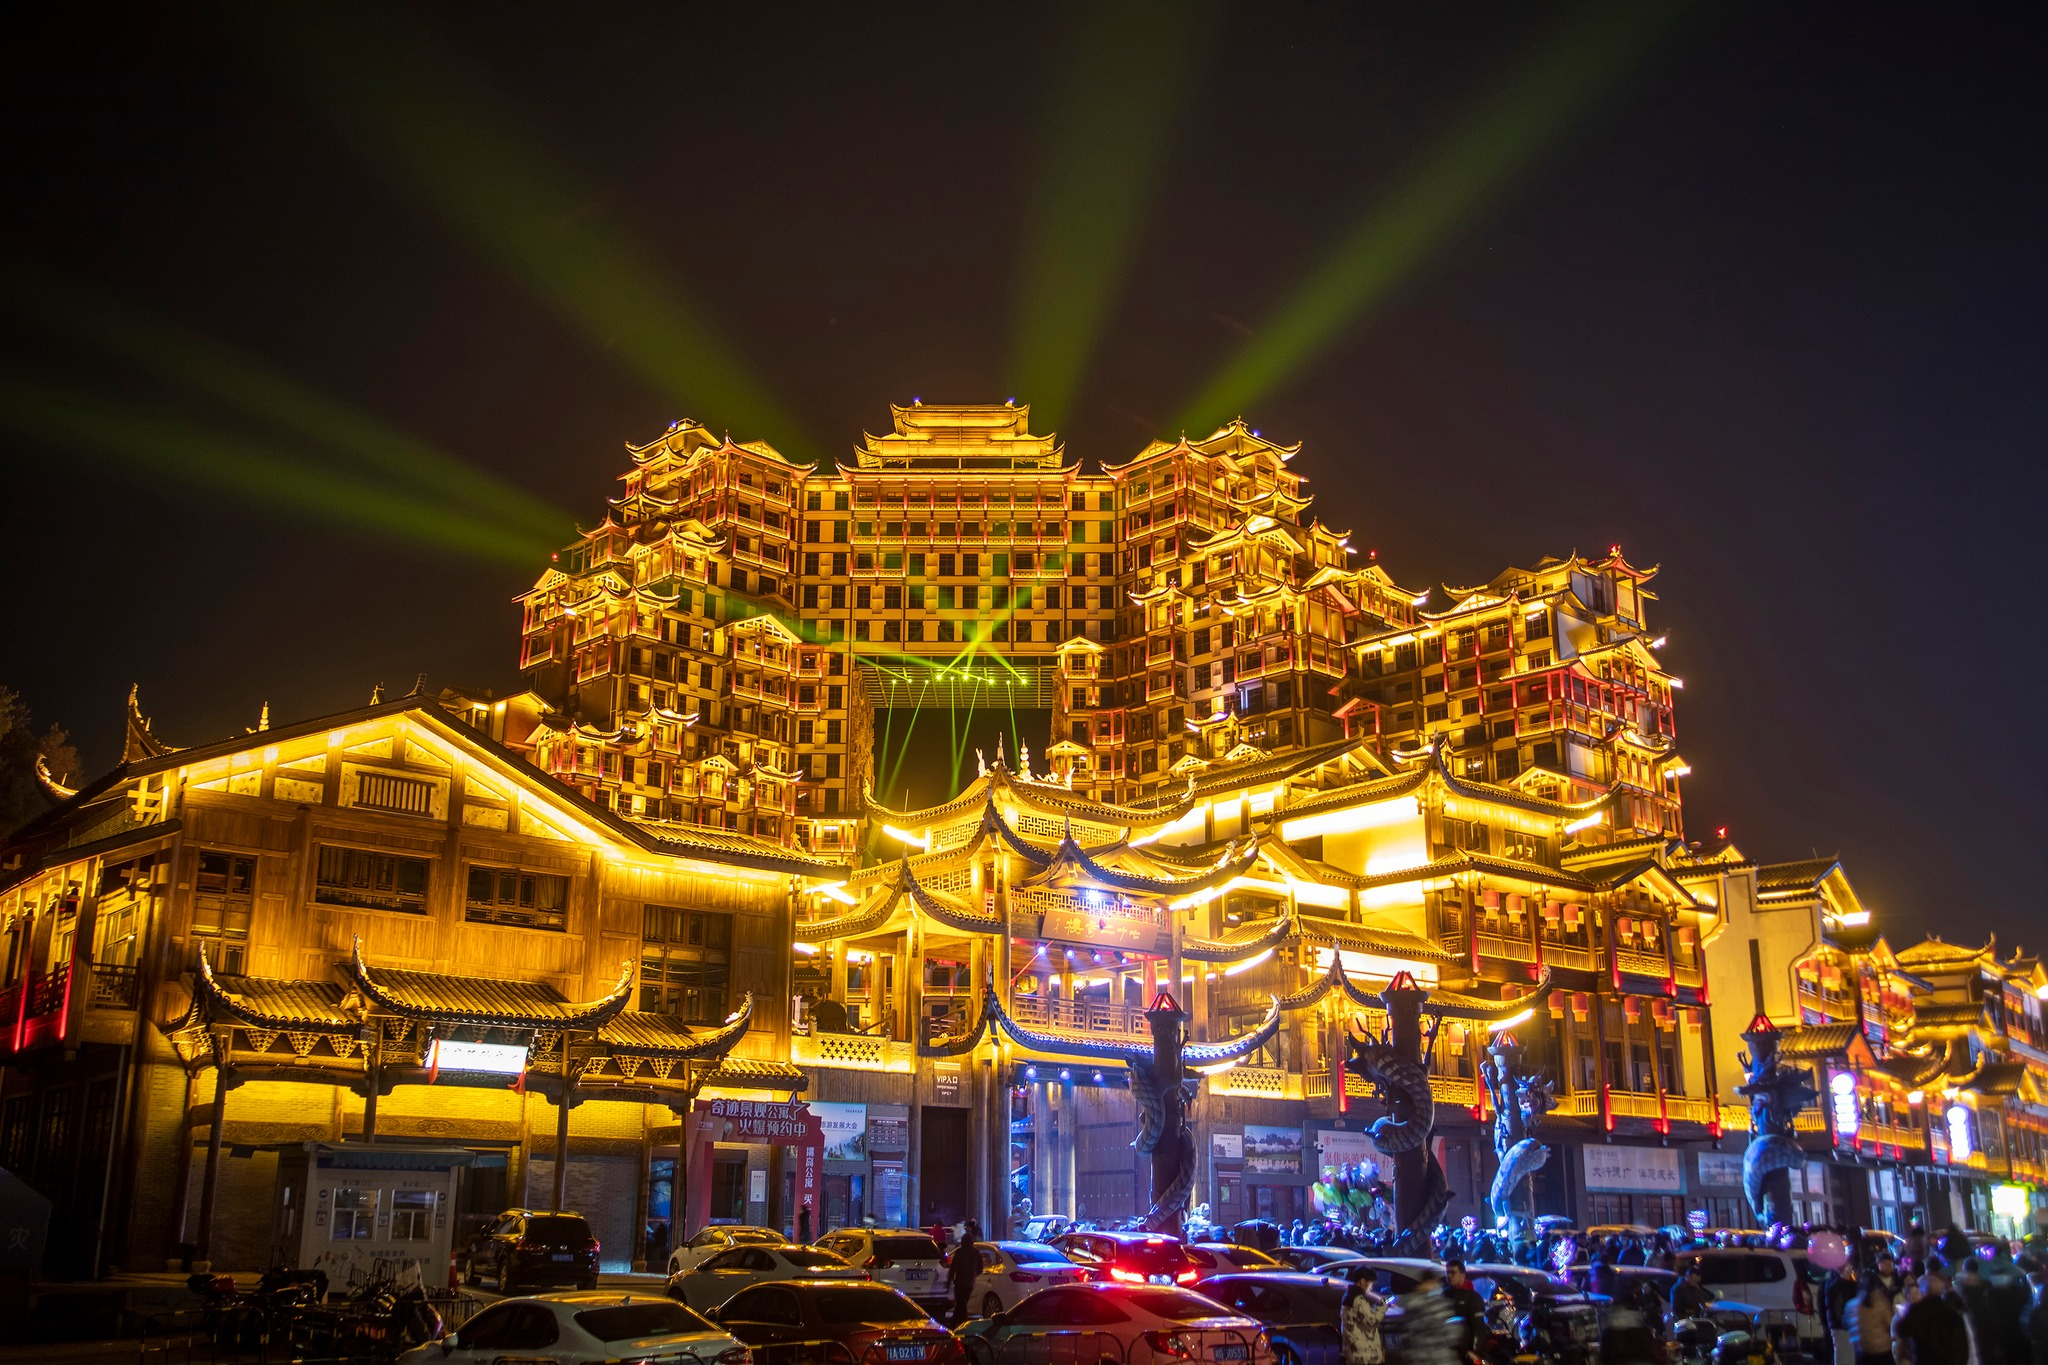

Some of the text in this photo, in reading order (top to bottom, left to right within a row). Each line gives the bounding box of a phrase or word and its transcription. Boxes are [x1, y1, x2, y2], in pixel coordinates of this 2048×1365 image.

[711, 1100, 790, 1119] 奇迹景观公寓
[740, 1119, 806, 1137] 火爆预约中
